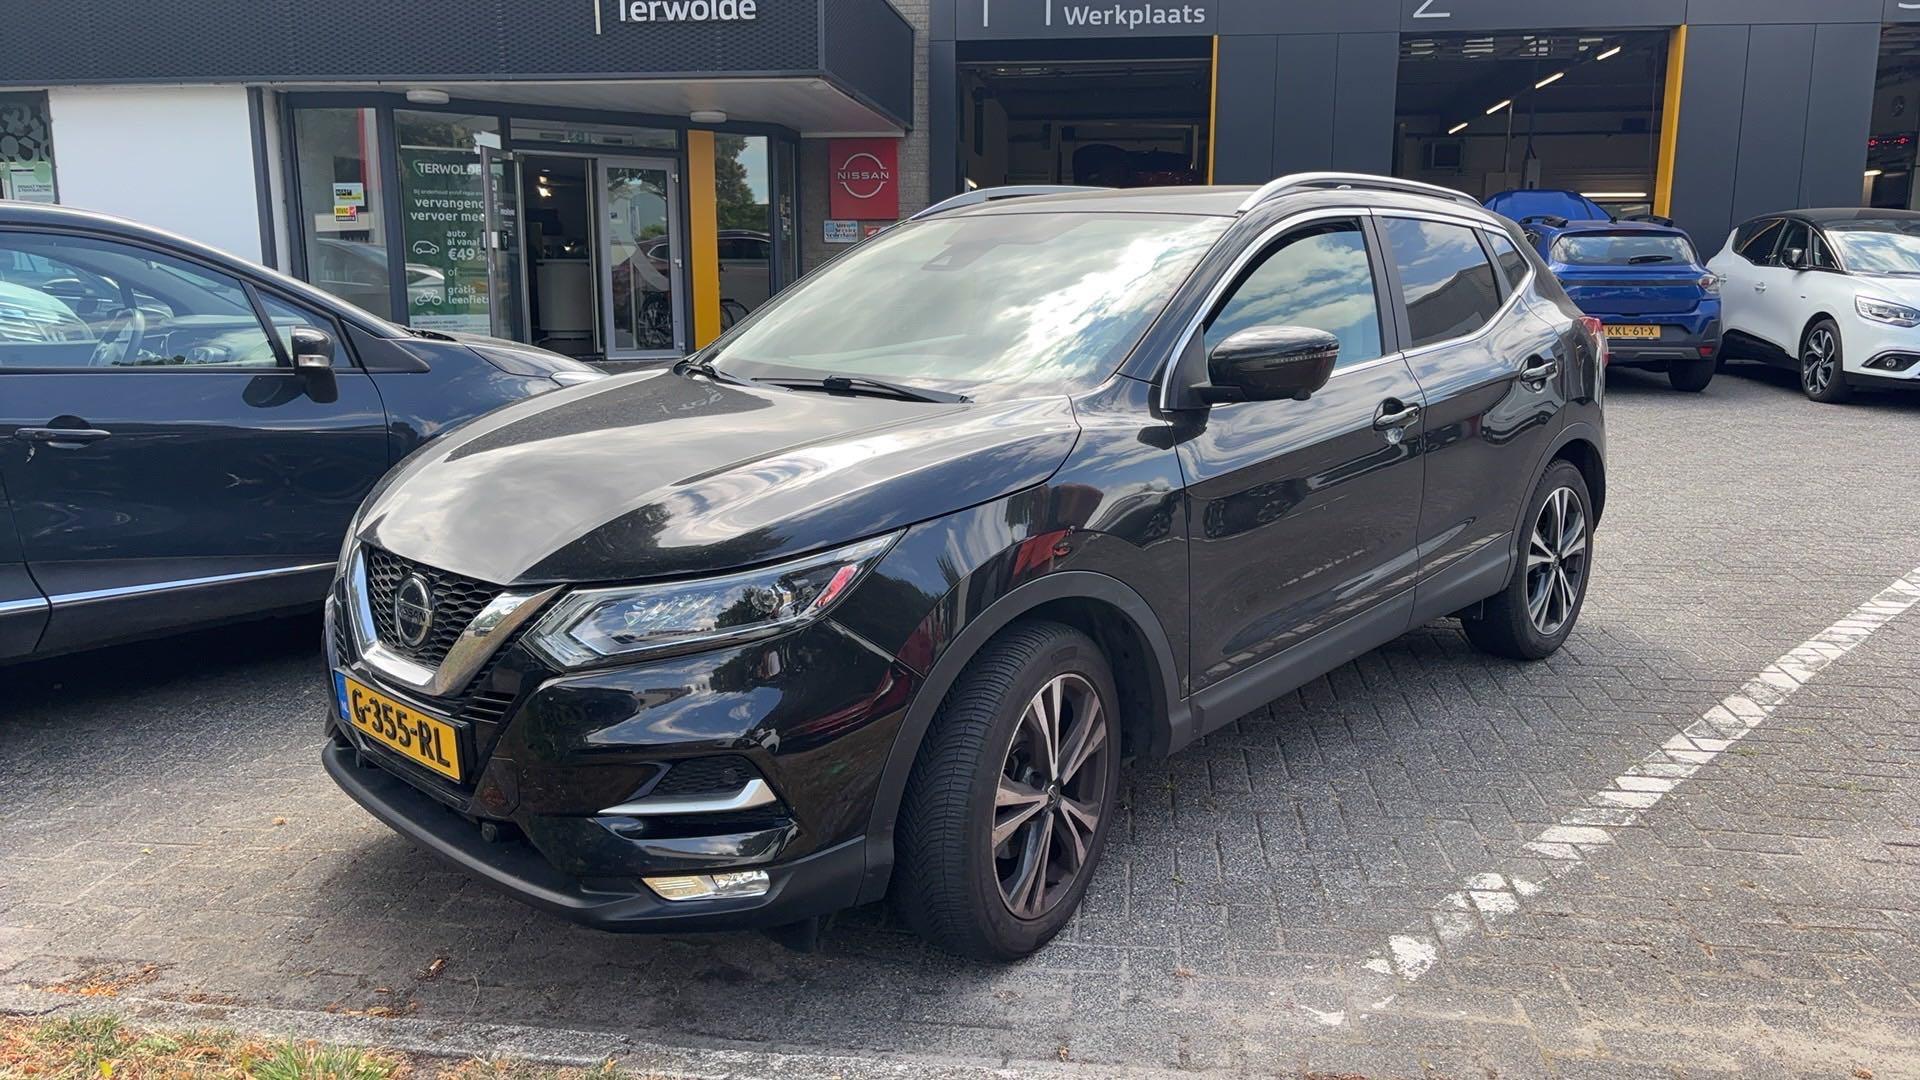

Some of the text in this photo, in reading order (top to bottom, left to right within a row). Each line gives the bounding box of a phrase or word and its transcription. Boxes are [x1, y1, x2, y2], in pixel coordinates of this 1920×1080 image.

[1064, 4, 1205, 29] Werkplaats
[411, 213, 457, 221] vervoer
[448, 248, 475, 261] €49
[448, 267, 457, 277] of
[448, 285, 476, 296] gratis
[1607, 327, 1654, 336] KKL-61-X
[352, 688, 450, 768] G-355-RL
